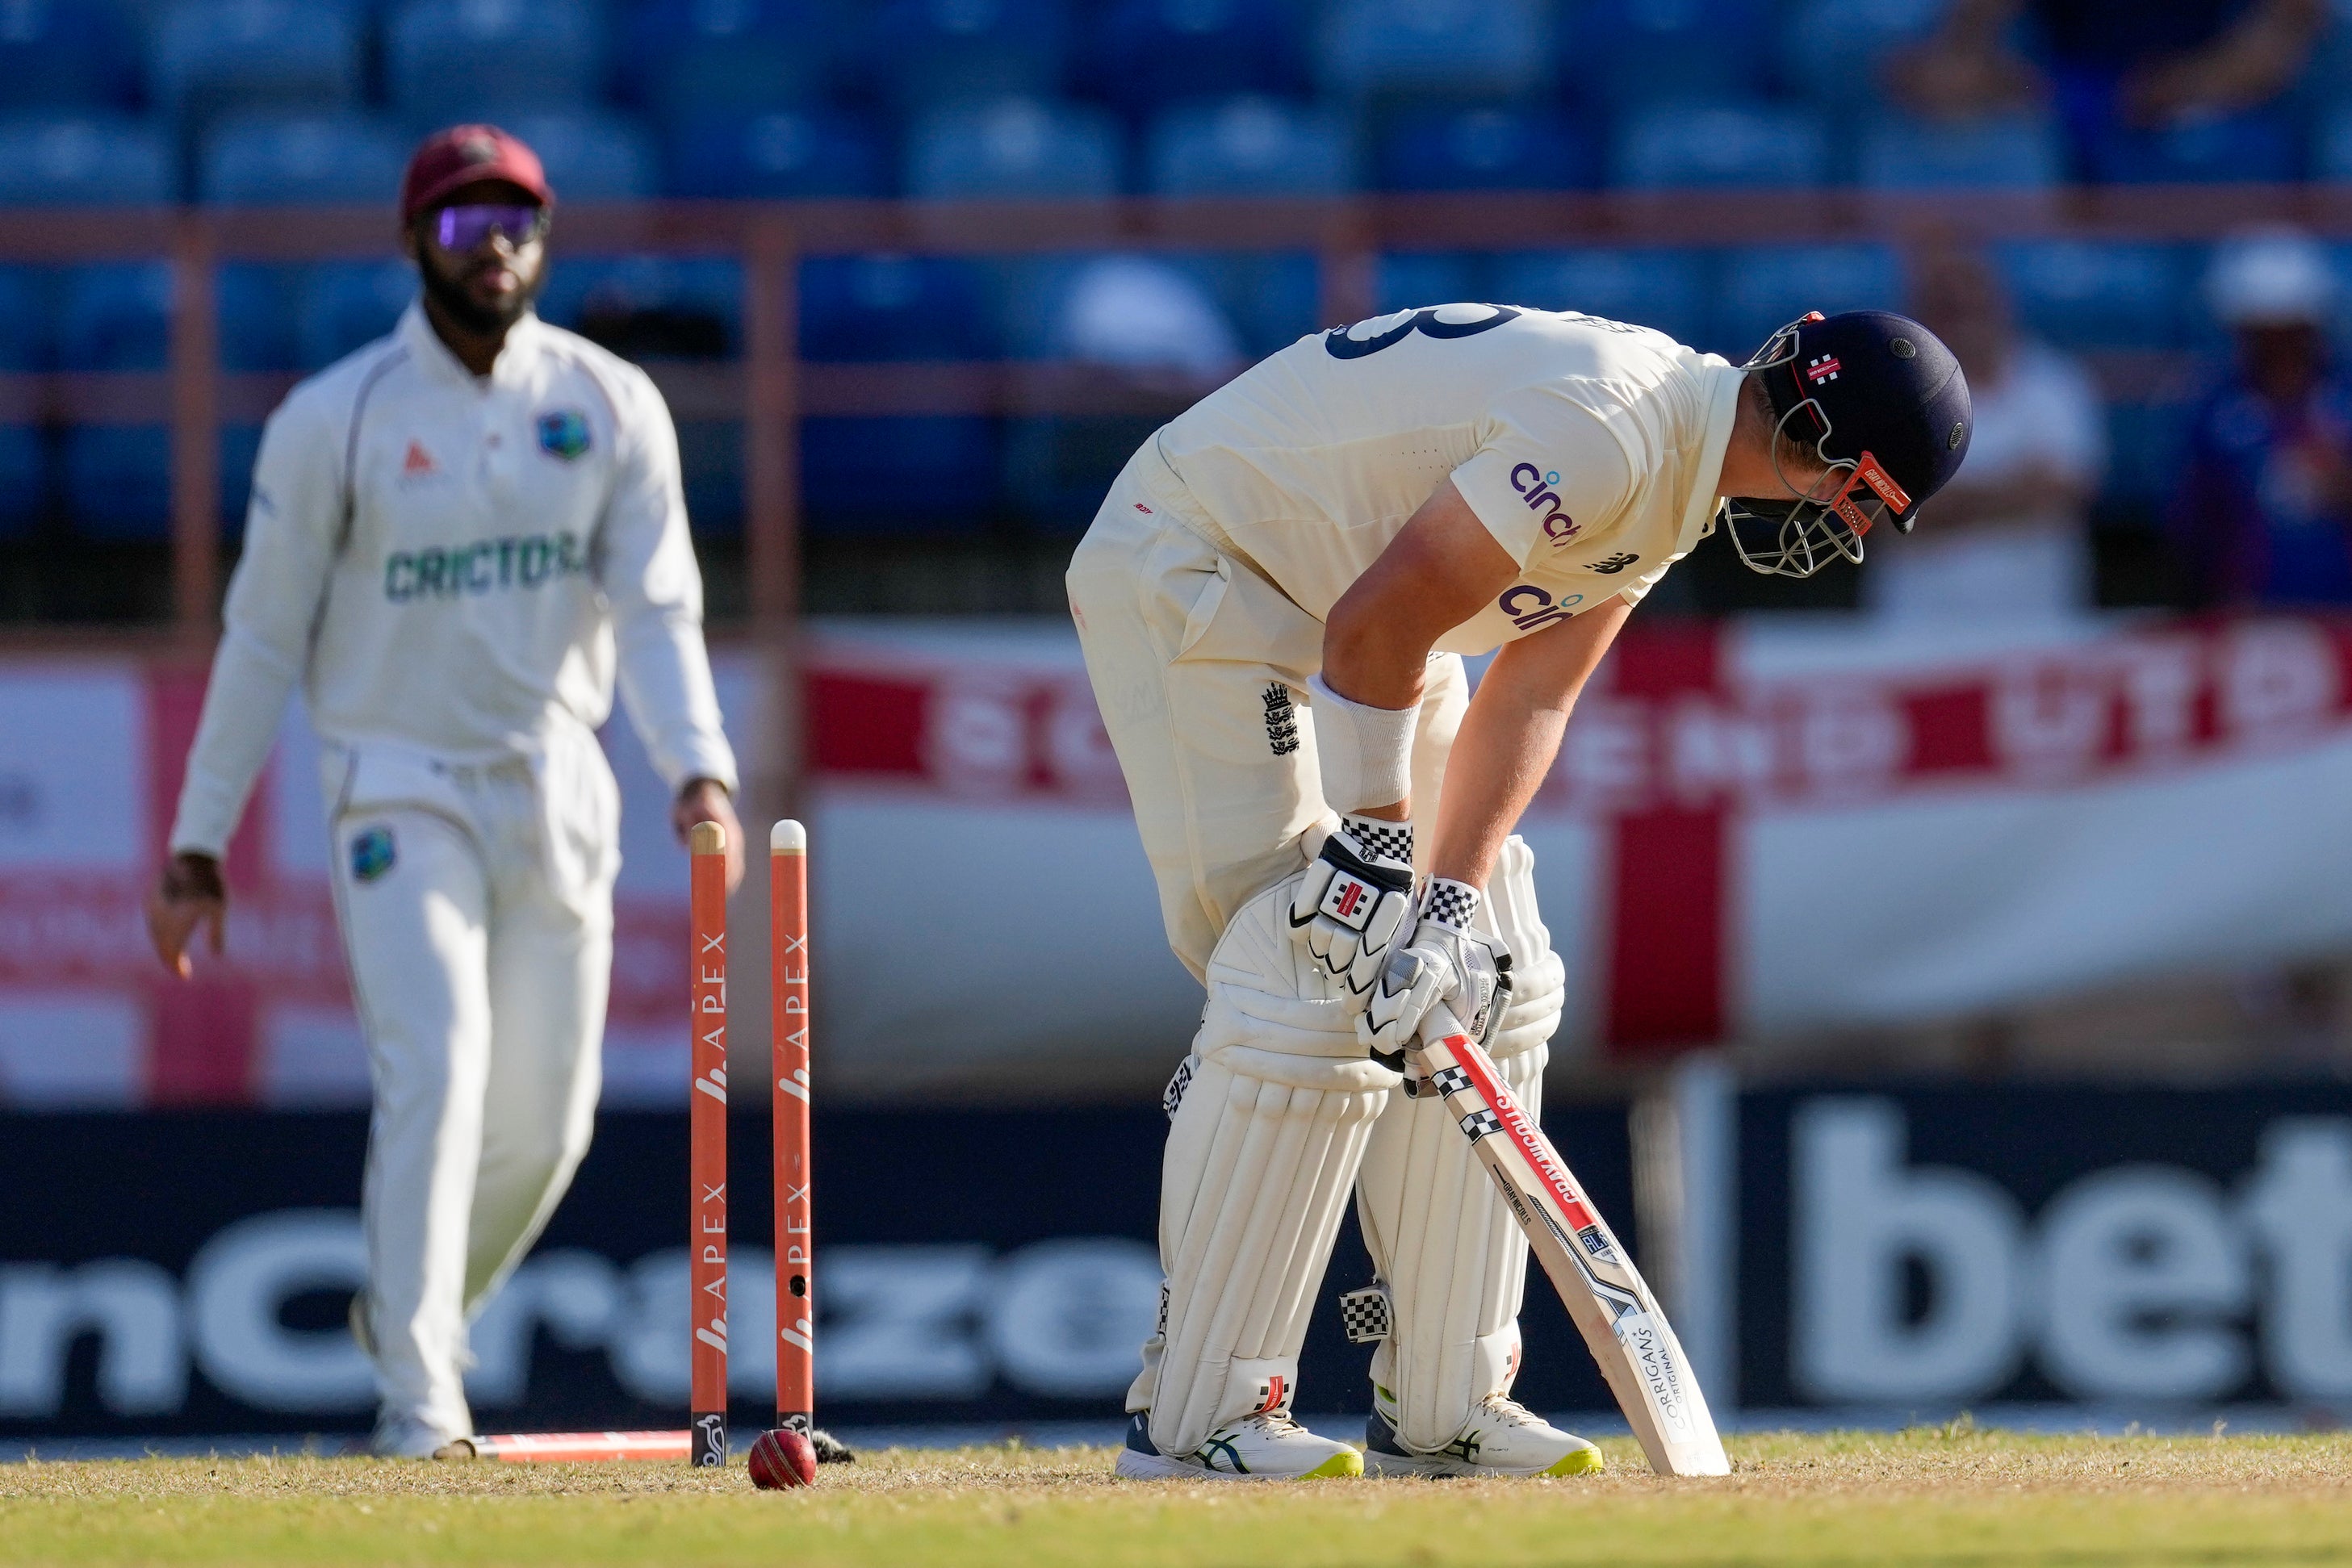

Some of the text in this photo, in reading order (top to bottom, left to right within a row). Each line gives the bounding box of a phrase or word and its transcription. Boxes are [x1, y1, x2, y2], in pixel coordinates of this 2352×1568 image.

[1510, 462, 1582, 548] cinch
[701, 932, 725, 1052] APEX
[785, 932, 809, 1052] APEX
[703, 1181, 726, 1302] APEX
[787, 1181, 810, 1302] PEX
[1638, 1328, 1685, 1430] CORRIGANS
[1658, 1348, 1683, 1404] ORIGINAL
